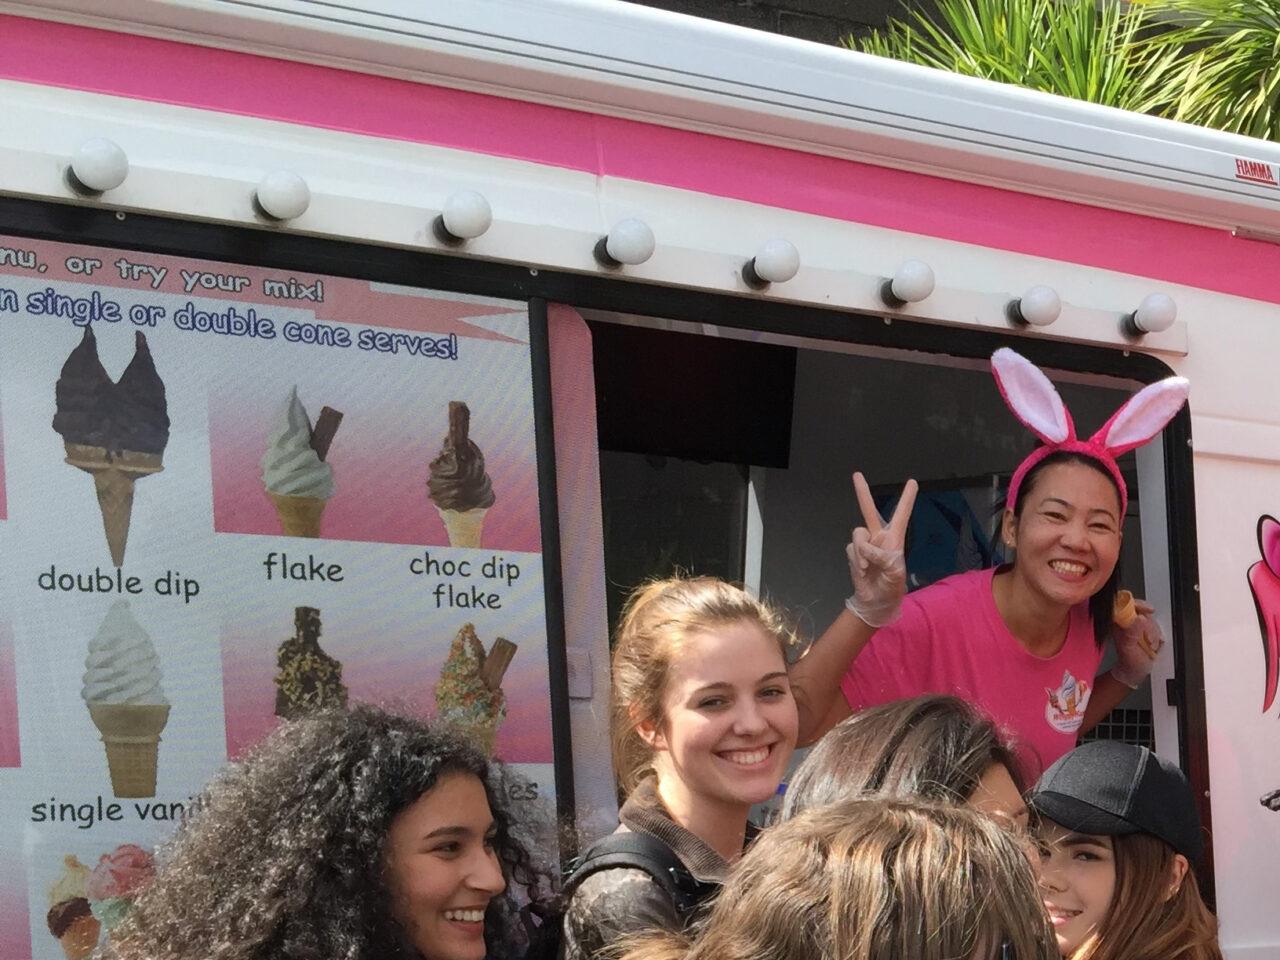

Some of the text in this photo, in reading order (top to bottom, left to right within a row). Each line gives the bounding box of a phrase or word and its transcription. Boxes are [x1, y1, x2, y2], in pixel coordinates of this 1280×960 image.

[1235, 158, 1275, 181] FIAMMA
[65, 256, 102, 275] or
[114, 258, 168, 288] try
[180, 269, 250, 292] your
[263, 278, 324, 301] mix!
[26, 287, 122, 327] single
[130, 304, 165, 327] or
[174, 302, 276, 338] double
[283, 321, 351, 347] cone
[358, 329, 458, 360] serves!
[263, 552, 345, 582] flake
[409, 551, 521, 584] choc dip
[37, 565, 200, 603] double dip
[433, 583, 502, 610] flake
[31, 795, 123, 829] single
